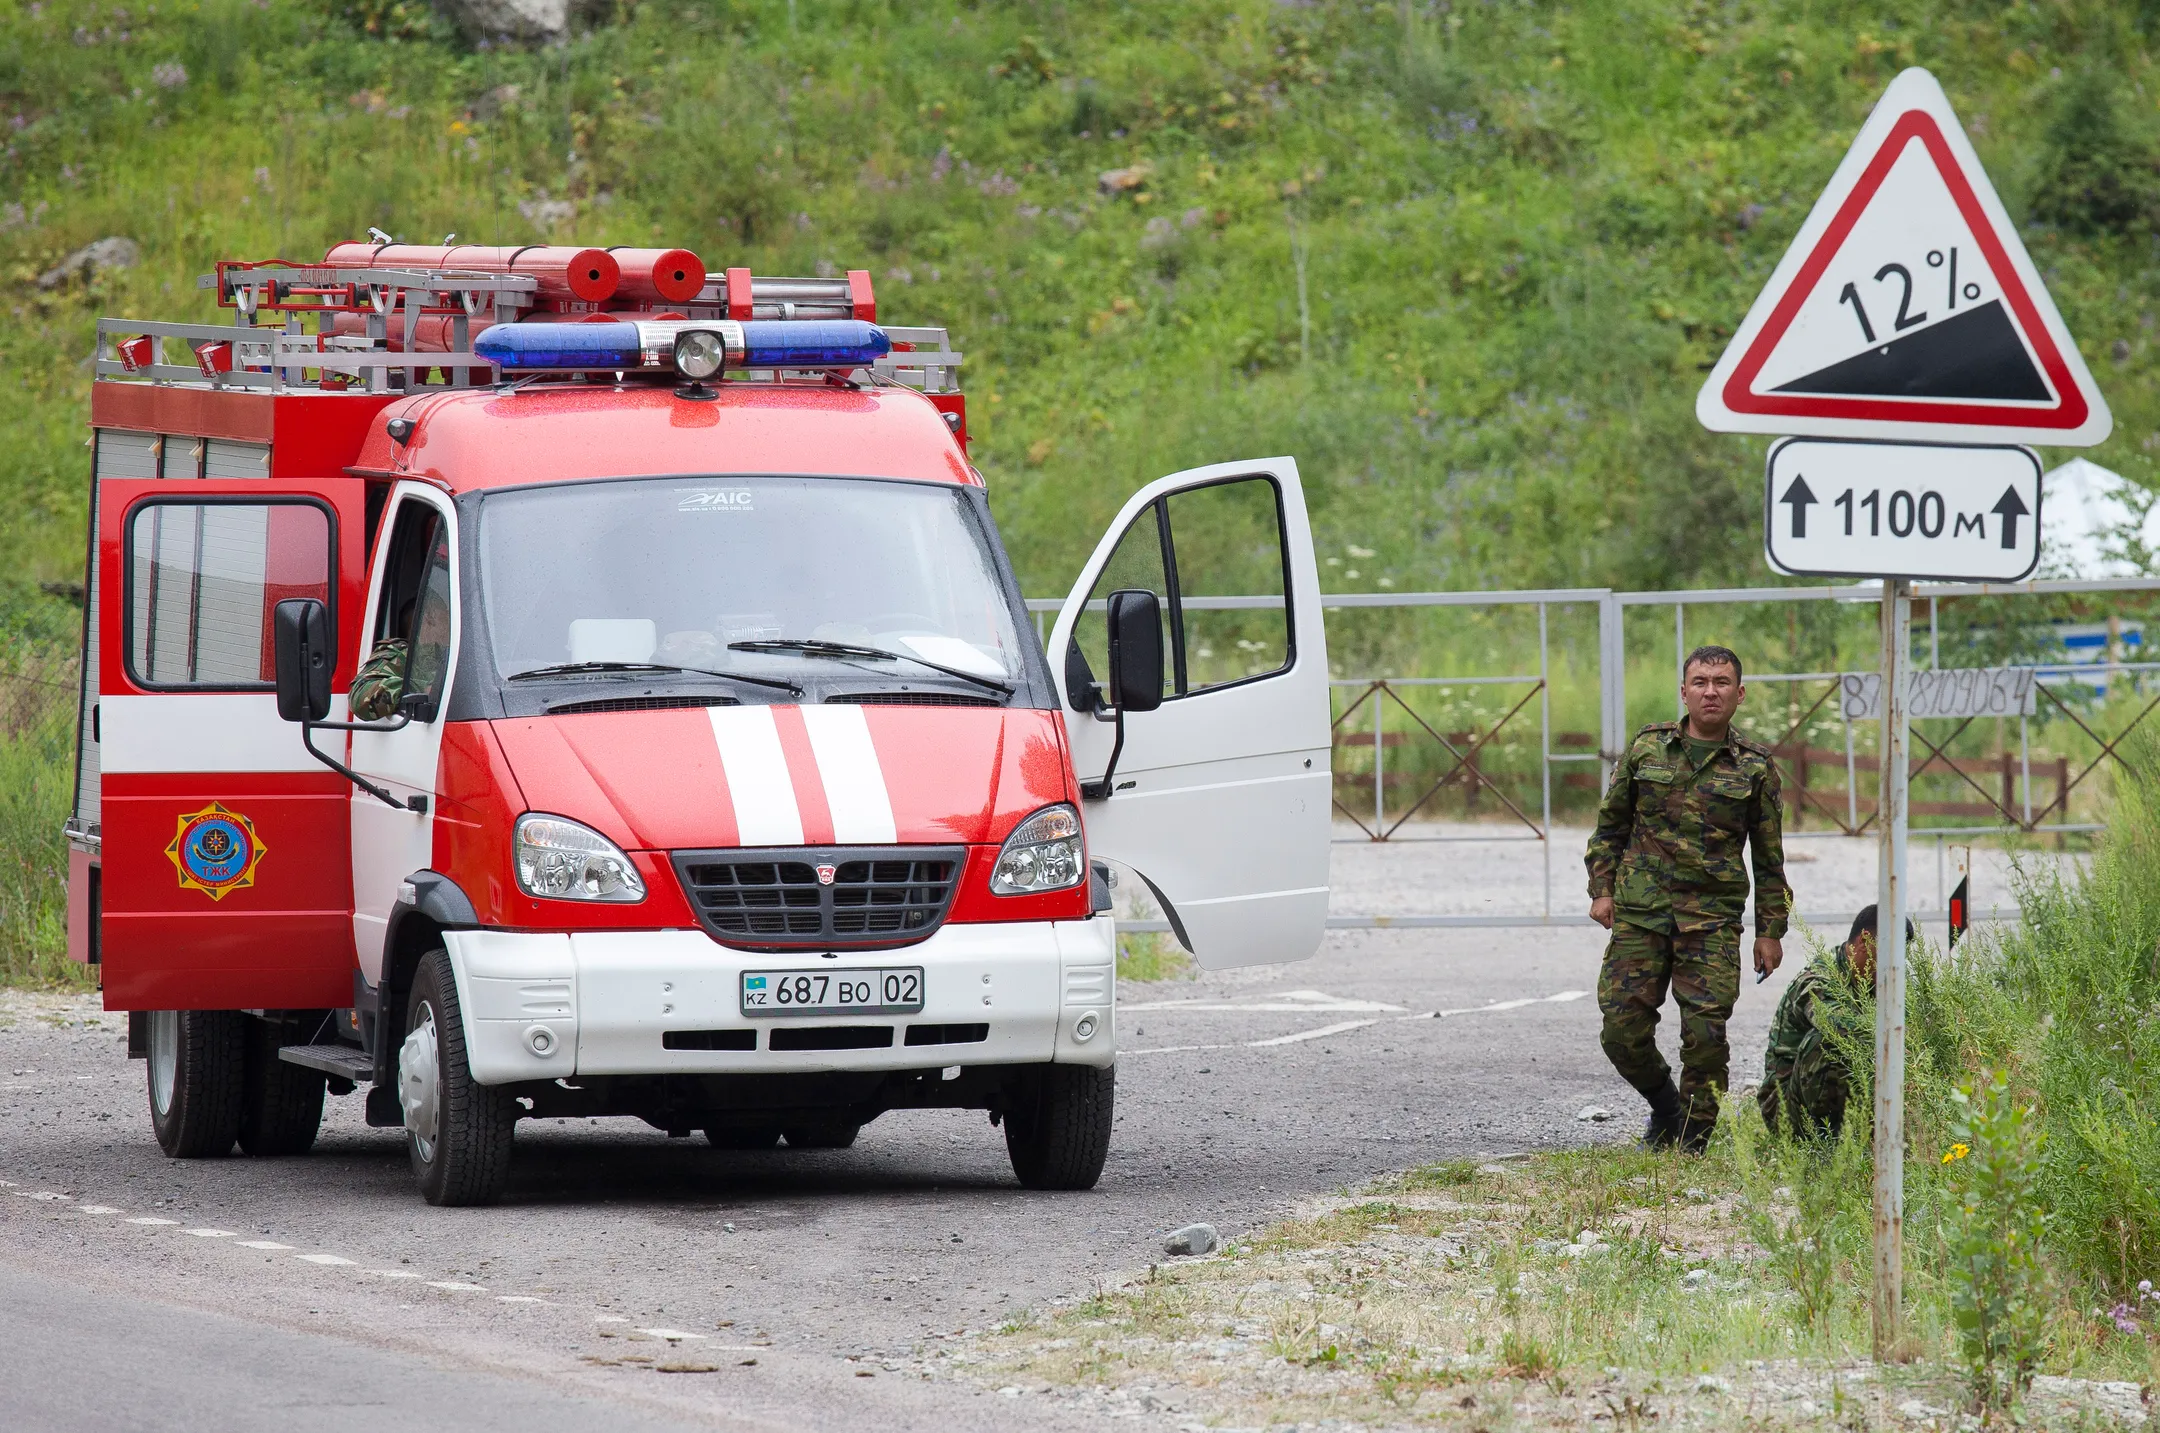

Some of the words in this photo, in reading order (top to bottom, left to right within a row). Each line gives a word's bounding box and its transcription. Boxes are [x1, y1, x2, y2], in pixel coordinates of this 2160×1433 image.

[1838, 246, 1981, 343] 12%
[1833, 488, 1945, 539] 1100
[201, 866, 231, 877] ТЖК
[745, 993, 767, 1005] KZ
[776, 975, 830, 1004] 687
[838, 981, 871, 1004] BO
[884, 973, 918, 1003] 02
